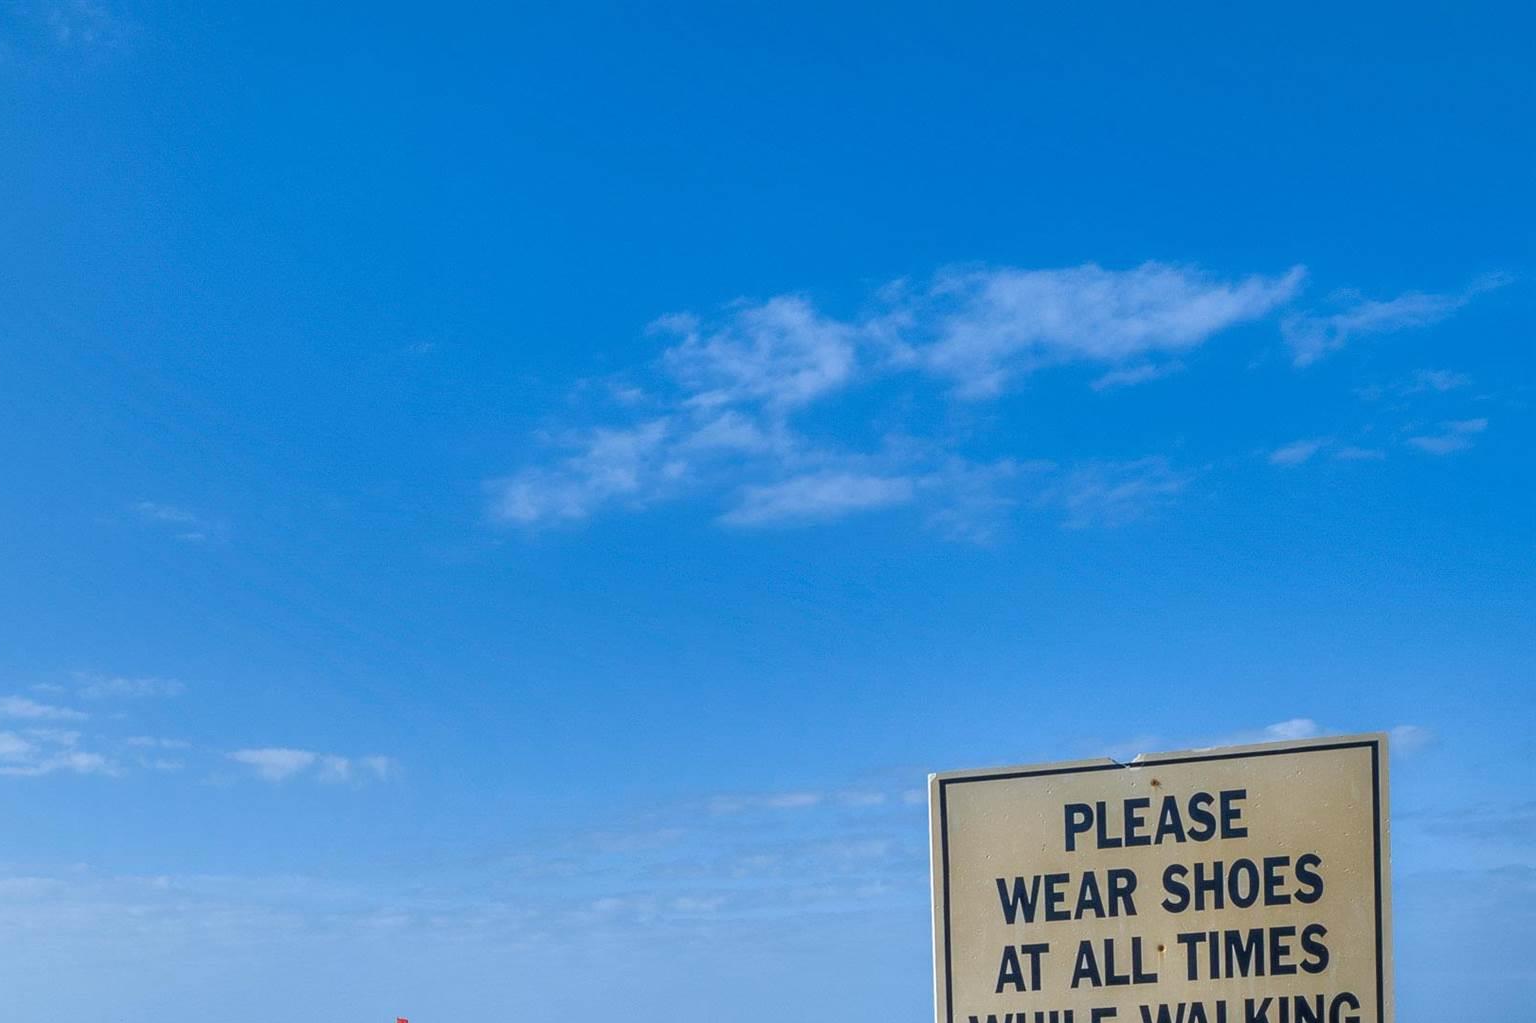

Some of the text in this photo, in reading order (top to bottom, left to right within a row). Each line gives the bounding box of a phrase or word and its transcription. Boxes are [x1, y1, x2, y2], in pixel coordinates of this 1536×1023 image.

[1063, 788, 1249, 853] PLEASE
[995, 853, 1324, 925] WEAR SHOES
[995, 923, 1330, 994] AT ALL TIMES
